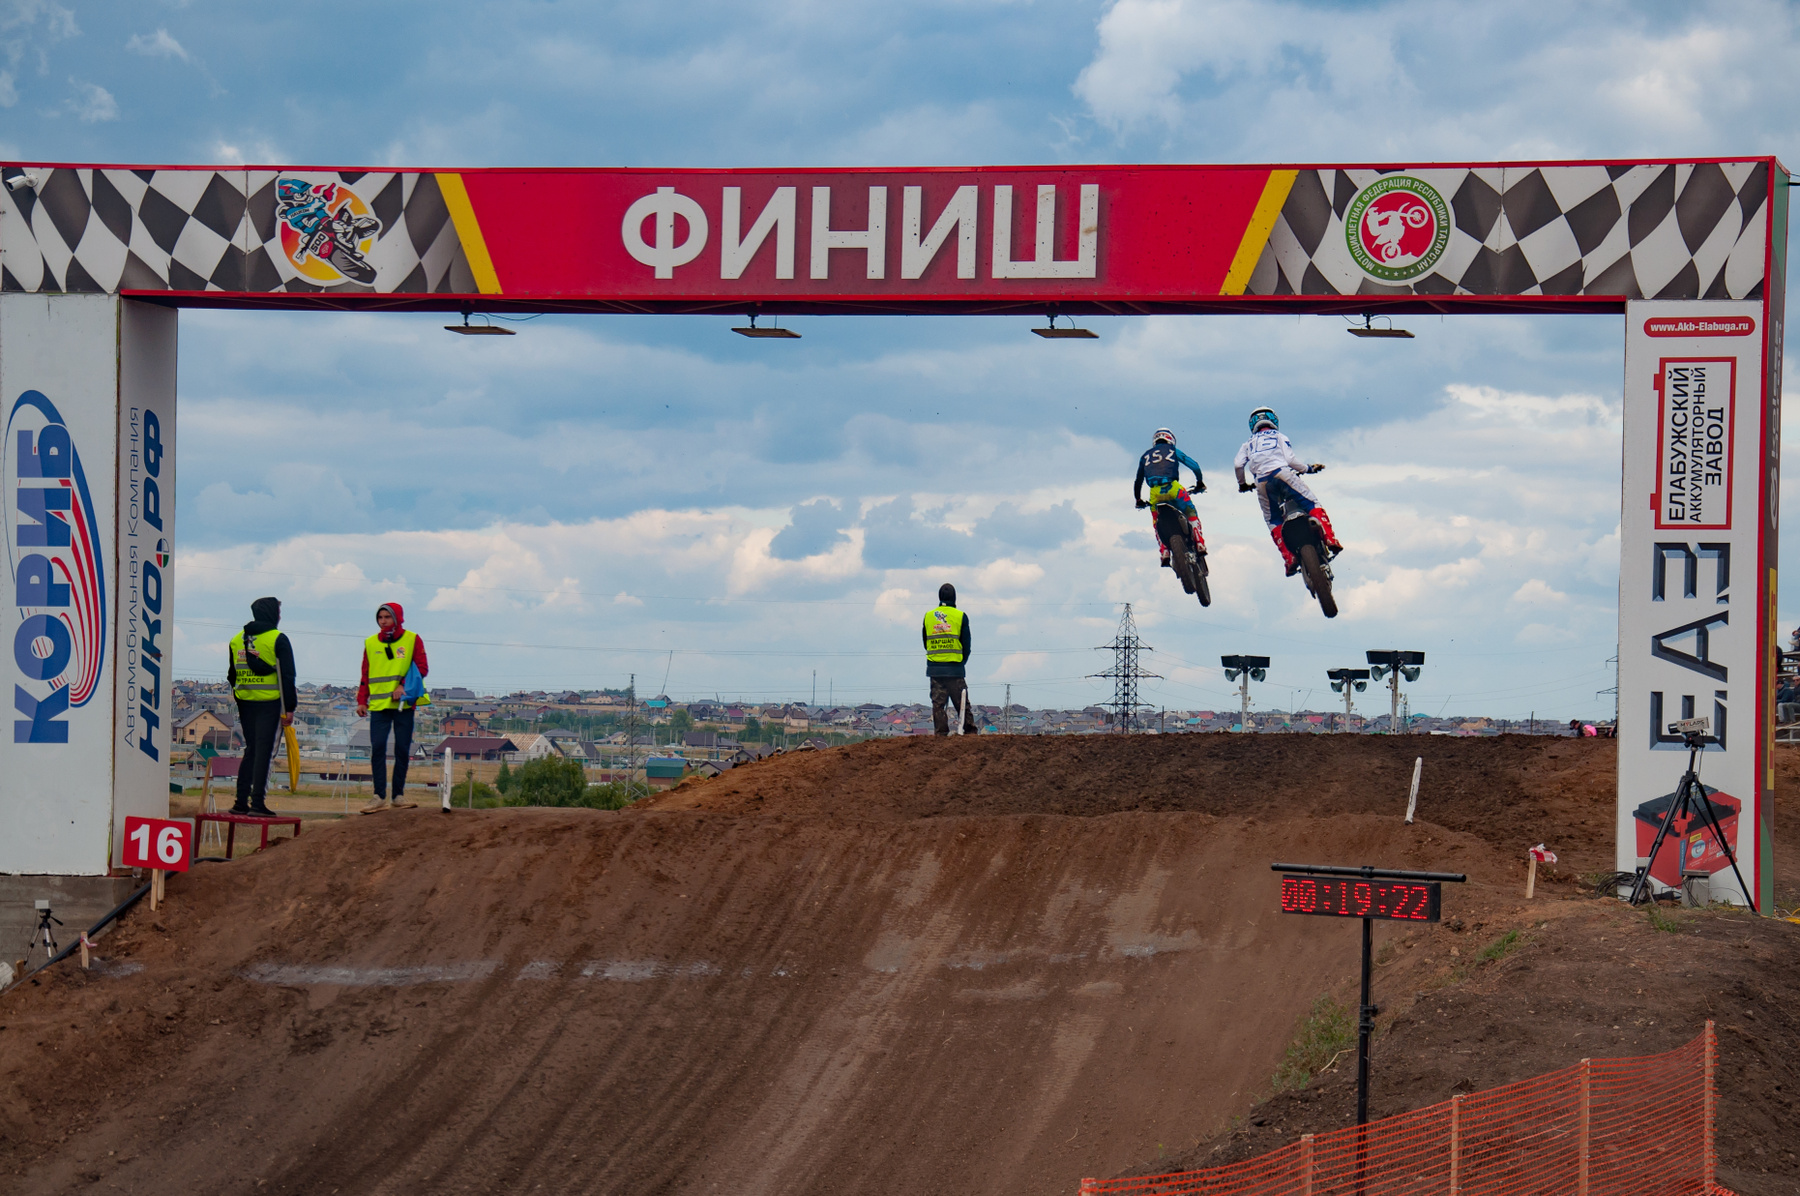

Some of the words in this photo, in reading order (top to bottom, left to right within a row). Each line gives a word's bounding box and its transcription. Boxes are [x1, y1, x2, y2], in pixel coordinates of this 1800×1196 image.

[1362, 178, 1412, 202] ФЕДЕРАЦИЯ
[1412, 180, 1448, 227] РЕСПУБЛИКИ
[621, 184, 1100, 280] ФИНИШ
[1348, 201, 1376, 272] МОТОЦИКЛЕТНАЯ
[1416, 228, 1448, 272] ТАТАРСТАН
[1650, 322, 1749, 333] www.Akb-Elabuga.ru
[128, 407, 139, 537] Компания
[1668, 367, 1690, 521] ЕЛАБУЖСКИЙ
[1689, 367, 1706, 523] АККУМУЛЯТОРНЫЙ
[1704, 407, 1724, 486] ЗАВОД
[14, 423, 71, 744] КОРИБ
[124, 545, 138, 748] Автомобильная
[1650, 542, 1731, 752] ЕАЗ
[1680, 719, 1705, 727] MYLAPS
[130, 823, 183, 864] 16
[1282, 879, 1428, 920] 00:19:22
